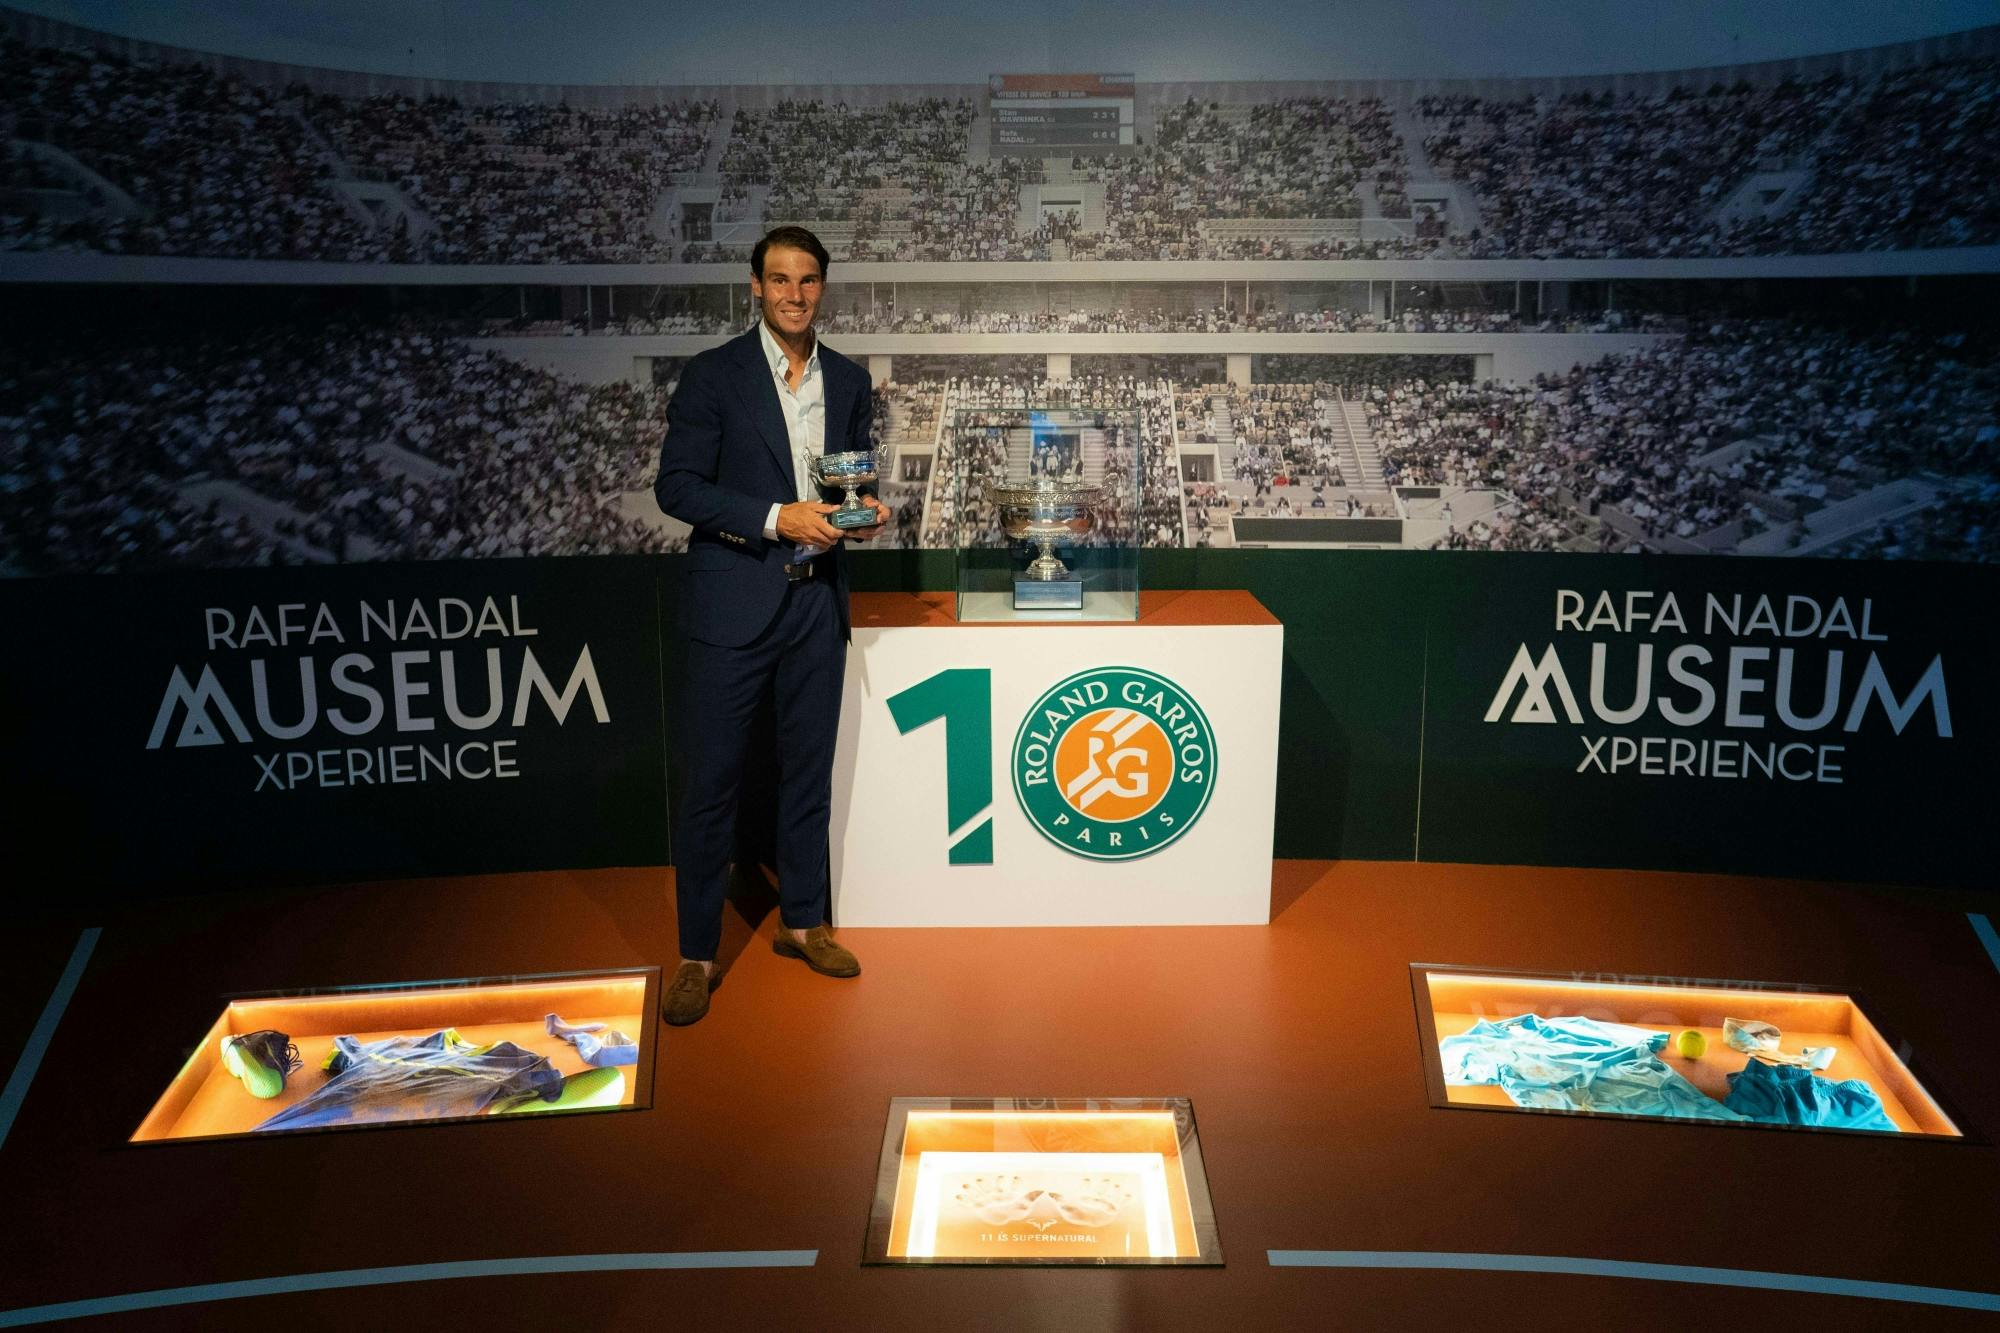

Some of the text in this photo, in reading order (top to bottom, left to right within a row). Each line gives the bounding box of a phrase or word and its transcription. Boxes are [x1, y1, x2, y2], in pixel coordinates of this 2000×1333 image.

[205, 595, 538, 650] RAFA NADAL
[1555, 589, 1888, 641] RAFA NADAL
[145, 643, 611, 749] MUSEUM
[1483, 641, 1953, 738] MUSEUM
[1024, 681, 1204, 788] ROLAND GARROS
[1576, 736, 1846, 783] XPERIENCE
[252, 740, 520, 791] XPERIENCE
[1053, 812, 1175, 846] PARIS
[998, 1233, 1009, 1242] IS
[1012, 1233, 1097, 1243] SUPERNATURAL
